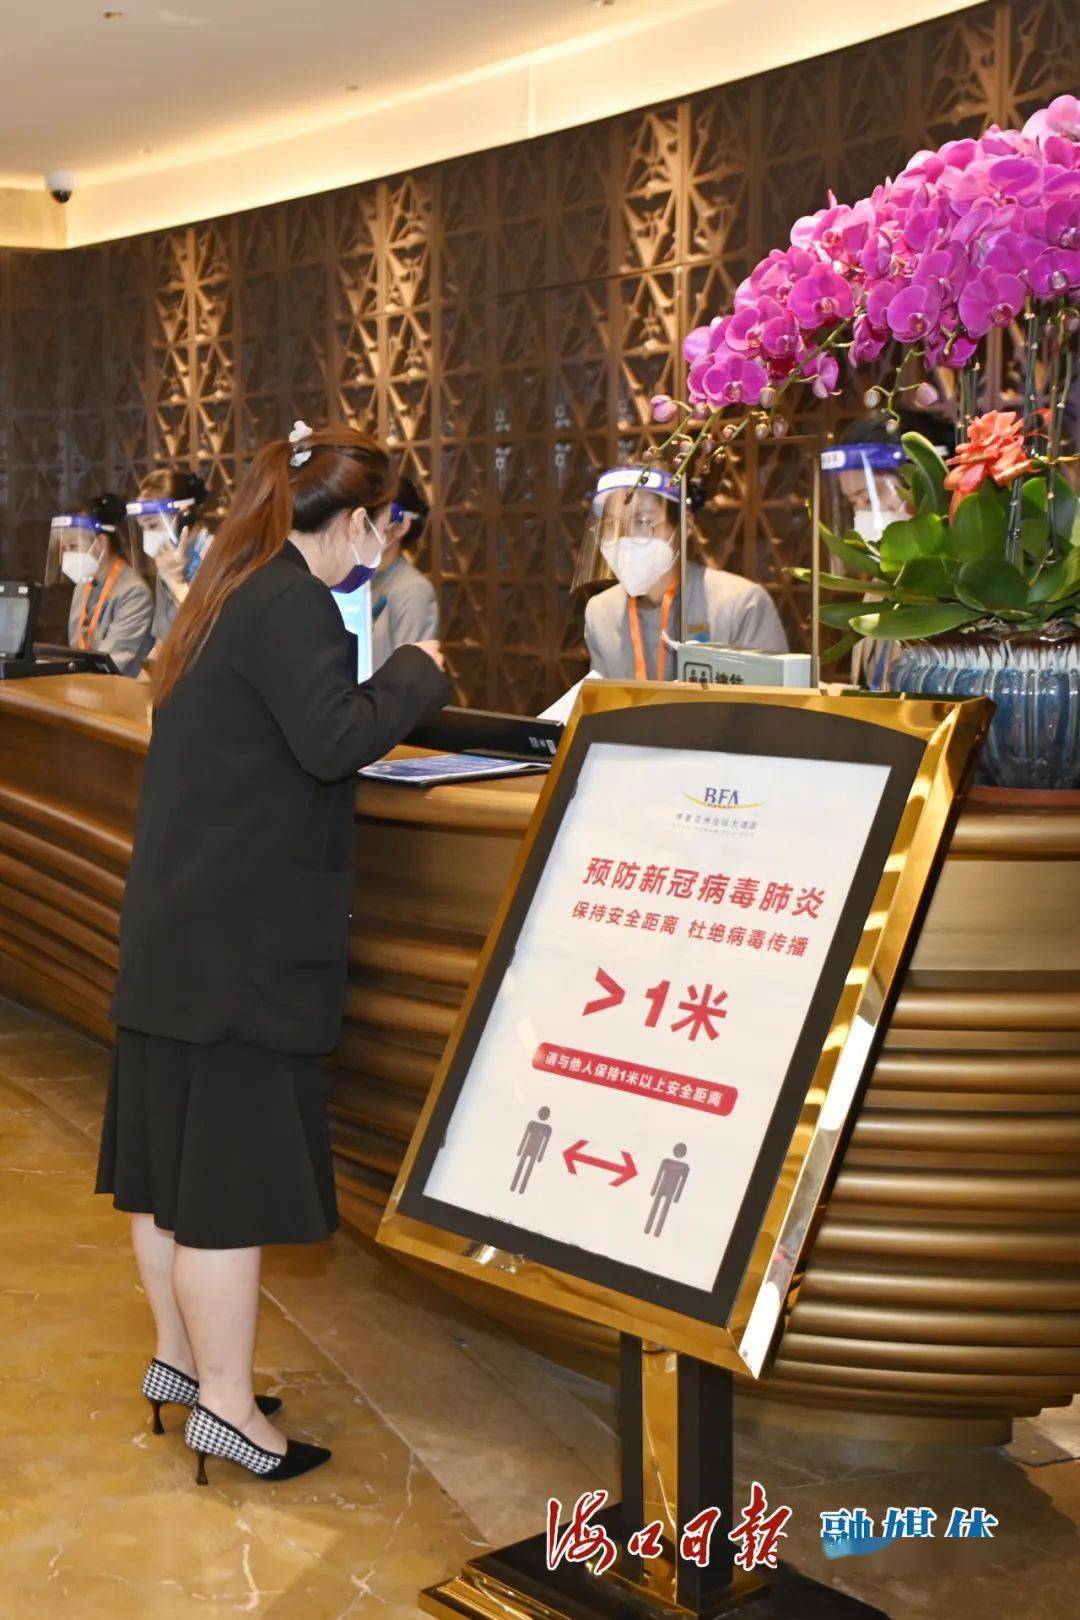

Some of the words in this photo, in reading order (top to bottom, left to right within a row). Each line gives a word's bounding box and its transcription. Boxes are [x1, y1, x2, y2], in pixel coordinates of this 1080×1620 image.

[704, 787, 739, 805] BFA
[582, 857, 826, 919] 预防新冠病毒肺炎
[571, 900, 680, 935] 保持安全距离
[687, 919, 809, 957] 杜绝病毒传播
[545, 1051, 723, 1107] 请与他人保持1米以上安全距离
